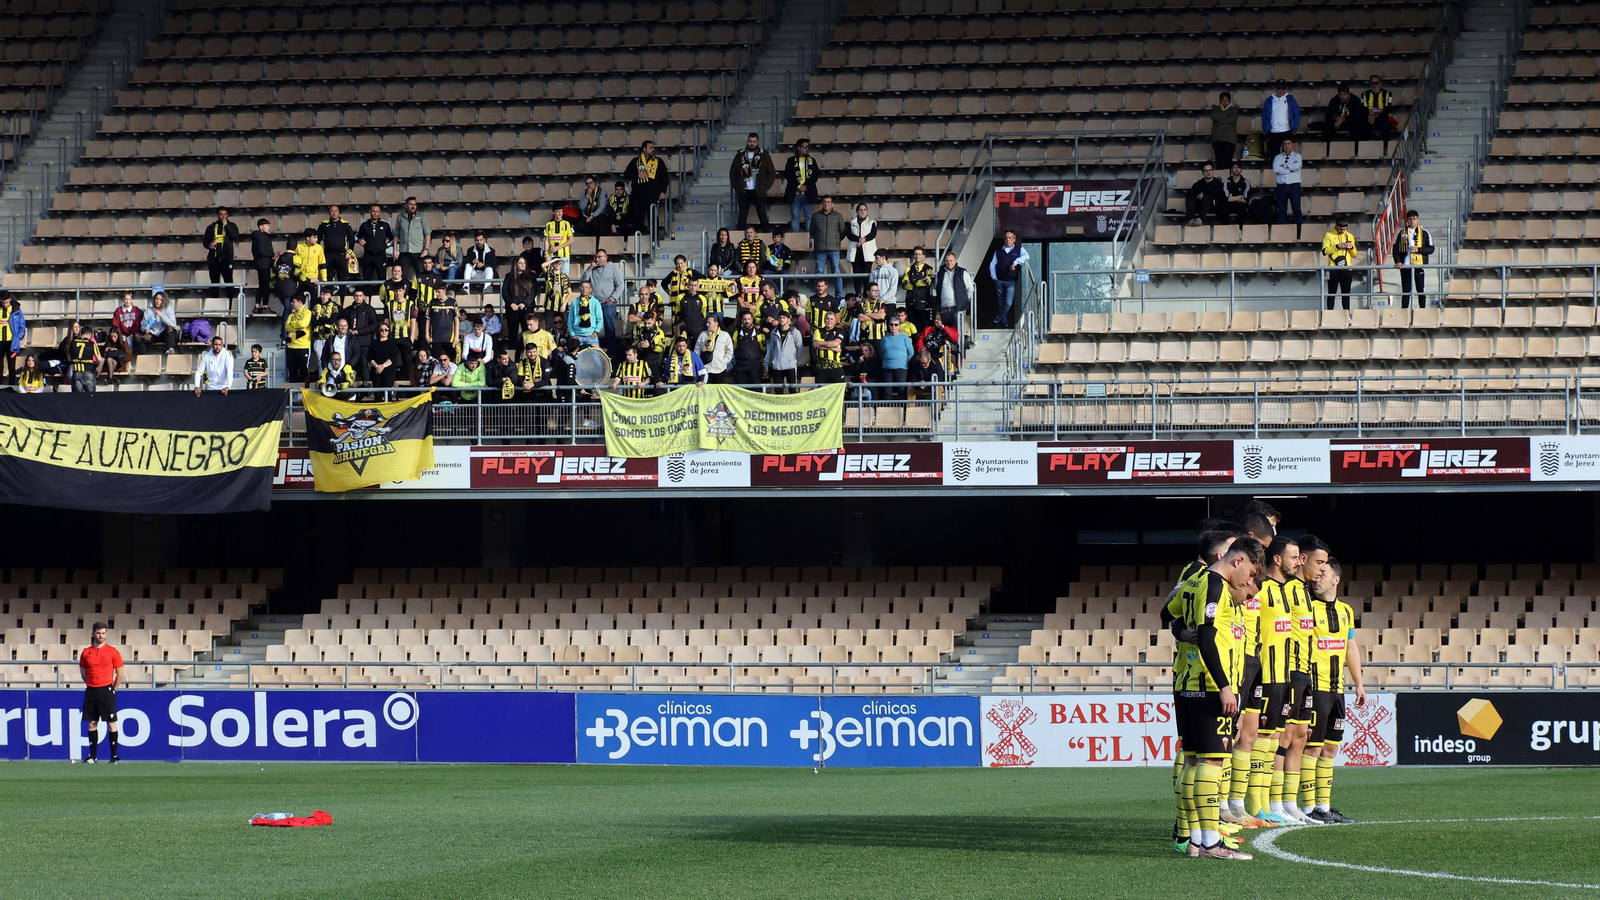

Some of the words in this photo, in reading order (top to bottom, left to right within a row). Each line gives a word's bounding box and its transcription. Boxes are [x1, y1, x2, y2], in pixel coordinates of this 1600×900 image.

[995, 192, 1057, 207] PLAY
[76, 342, 86, 358] 7
[744, 410, 802, 422] DECIDIMOS
[806, 408, 826, 419] SER
[615, 427, 646, 438] SOMOS
[649, 427, 665, 437] LOS
[747, 424, 767, 435] LOS
[771, 422, 821, 436] MEJORES
[336, 435, 382, 453] PASIÓN
[482, 458, 548, 474] PLAY
[763, 455, 831, 472] PLAY
[976, 458, 1028, 466] Ayuntamiento
[1050, 454, 1119, 470] PLAY
[1267, 456, 1321, 464] Ayuntamiento
[1343, 451, 1413, 468] PLAY
[1575, 460, 1595, 468] Jerez
[1327, 641, 1345, 650] jamón
[658, 700, 712, 715] clínicas
[862, 700, 917, 715] clínicas
[1050, 703, 1109, 724] BAR
[1117, 702, 1176, 724] RES
[168, 692, 377, 748] Solera
[1217, 717, 1232, 735] 23
[1415, 735, 1476, 753] indeso
[1468, 754, 1491, 763] group
